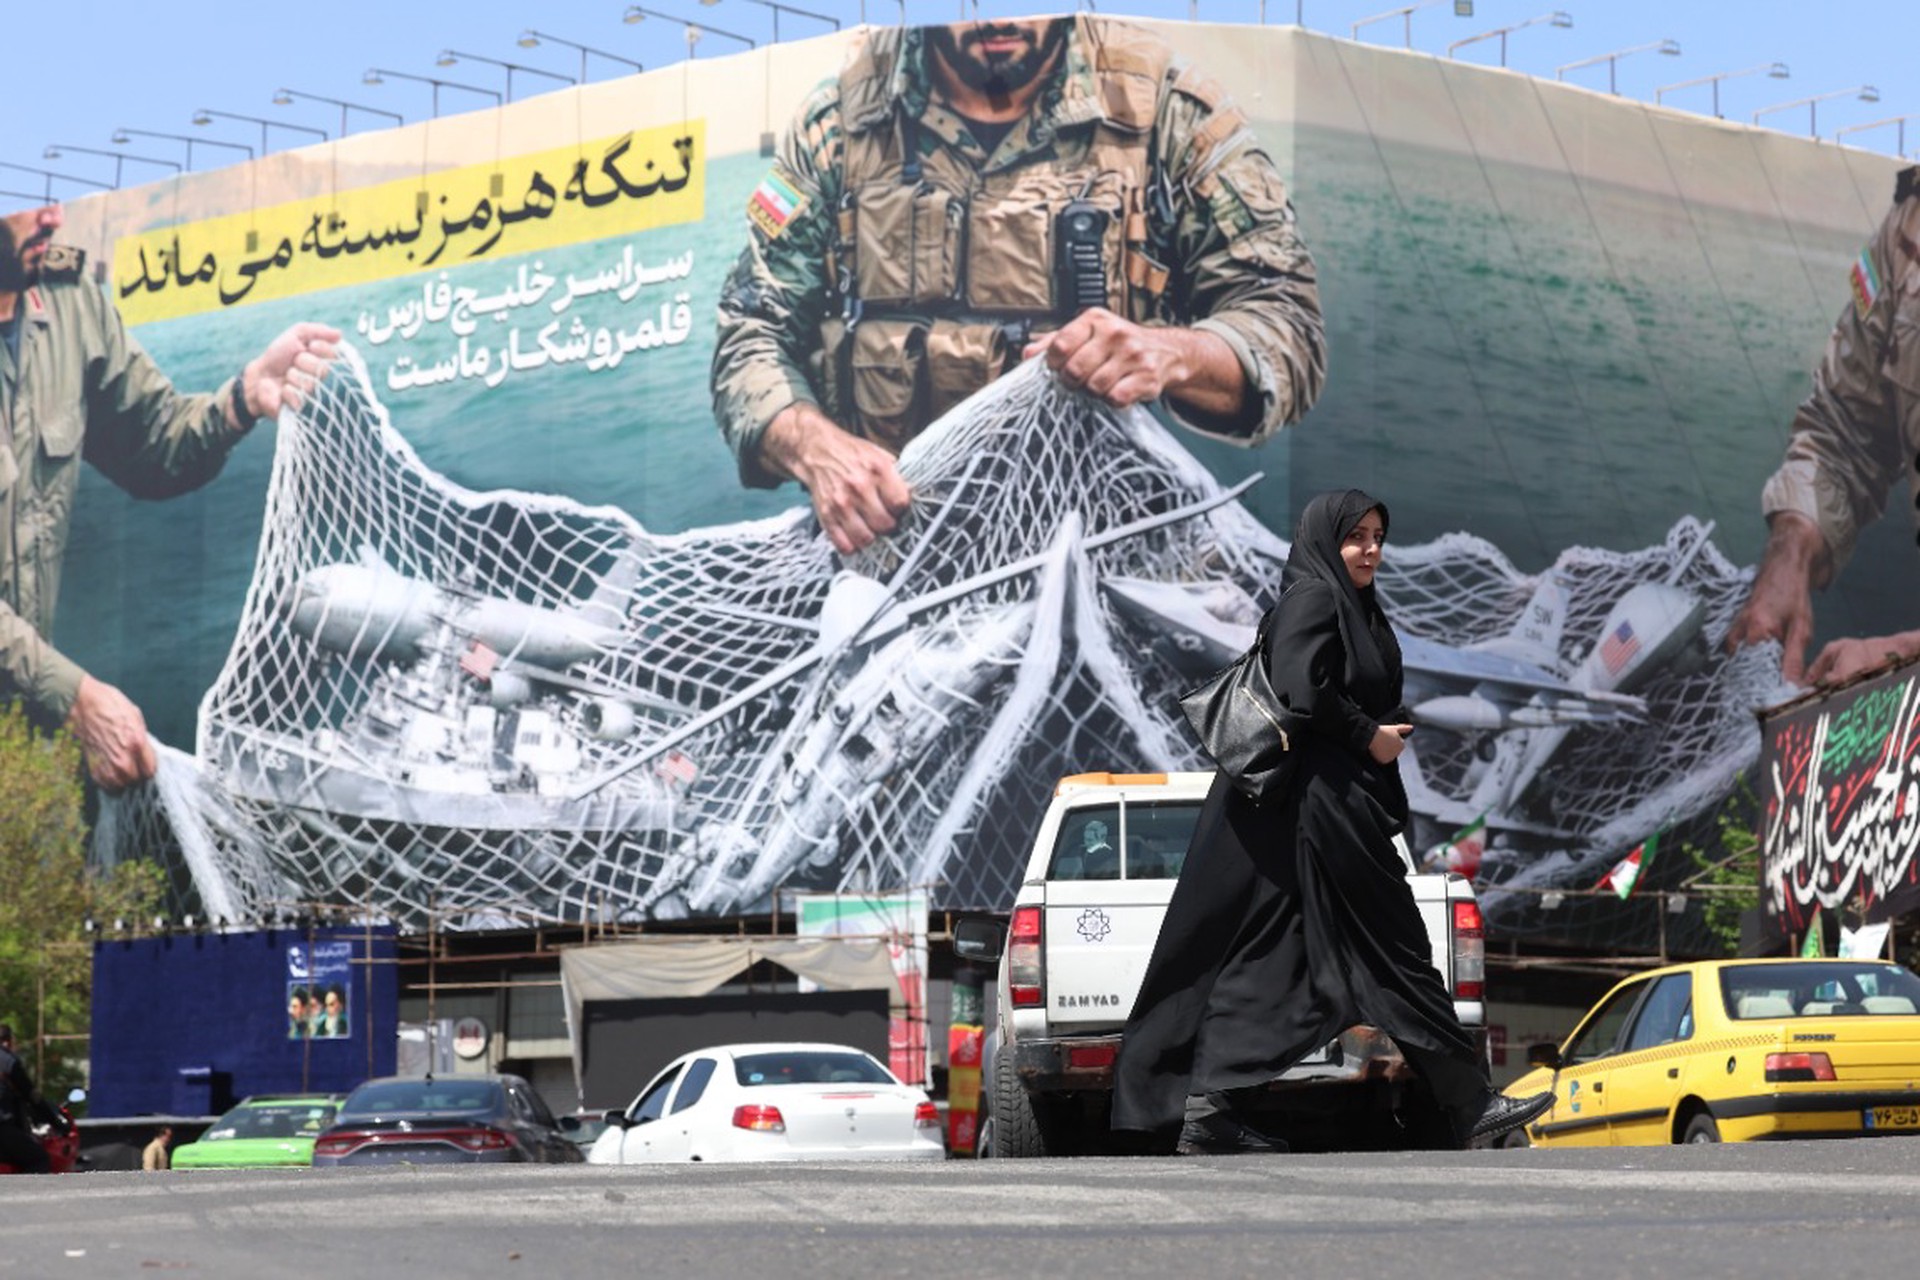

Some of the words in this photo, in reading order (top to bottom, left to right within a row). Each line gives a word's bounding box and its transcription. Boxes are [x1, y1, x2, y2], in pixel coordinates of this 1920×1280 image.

[564, 131, 694, 209] تنگه
[300, 207, 423, 261] بسته
[420, 170, 557, 267] هرمز
[450, 259, 557, 336] خلیج
[551, 245, 694, 313] سراسر
[386, 336, 492, 391] ماست
[483, 314, 592, 389] شکار
[586, 291, 694, 372] قلمرو
[1058, 994, 1120, 1008] ZAMYAD
